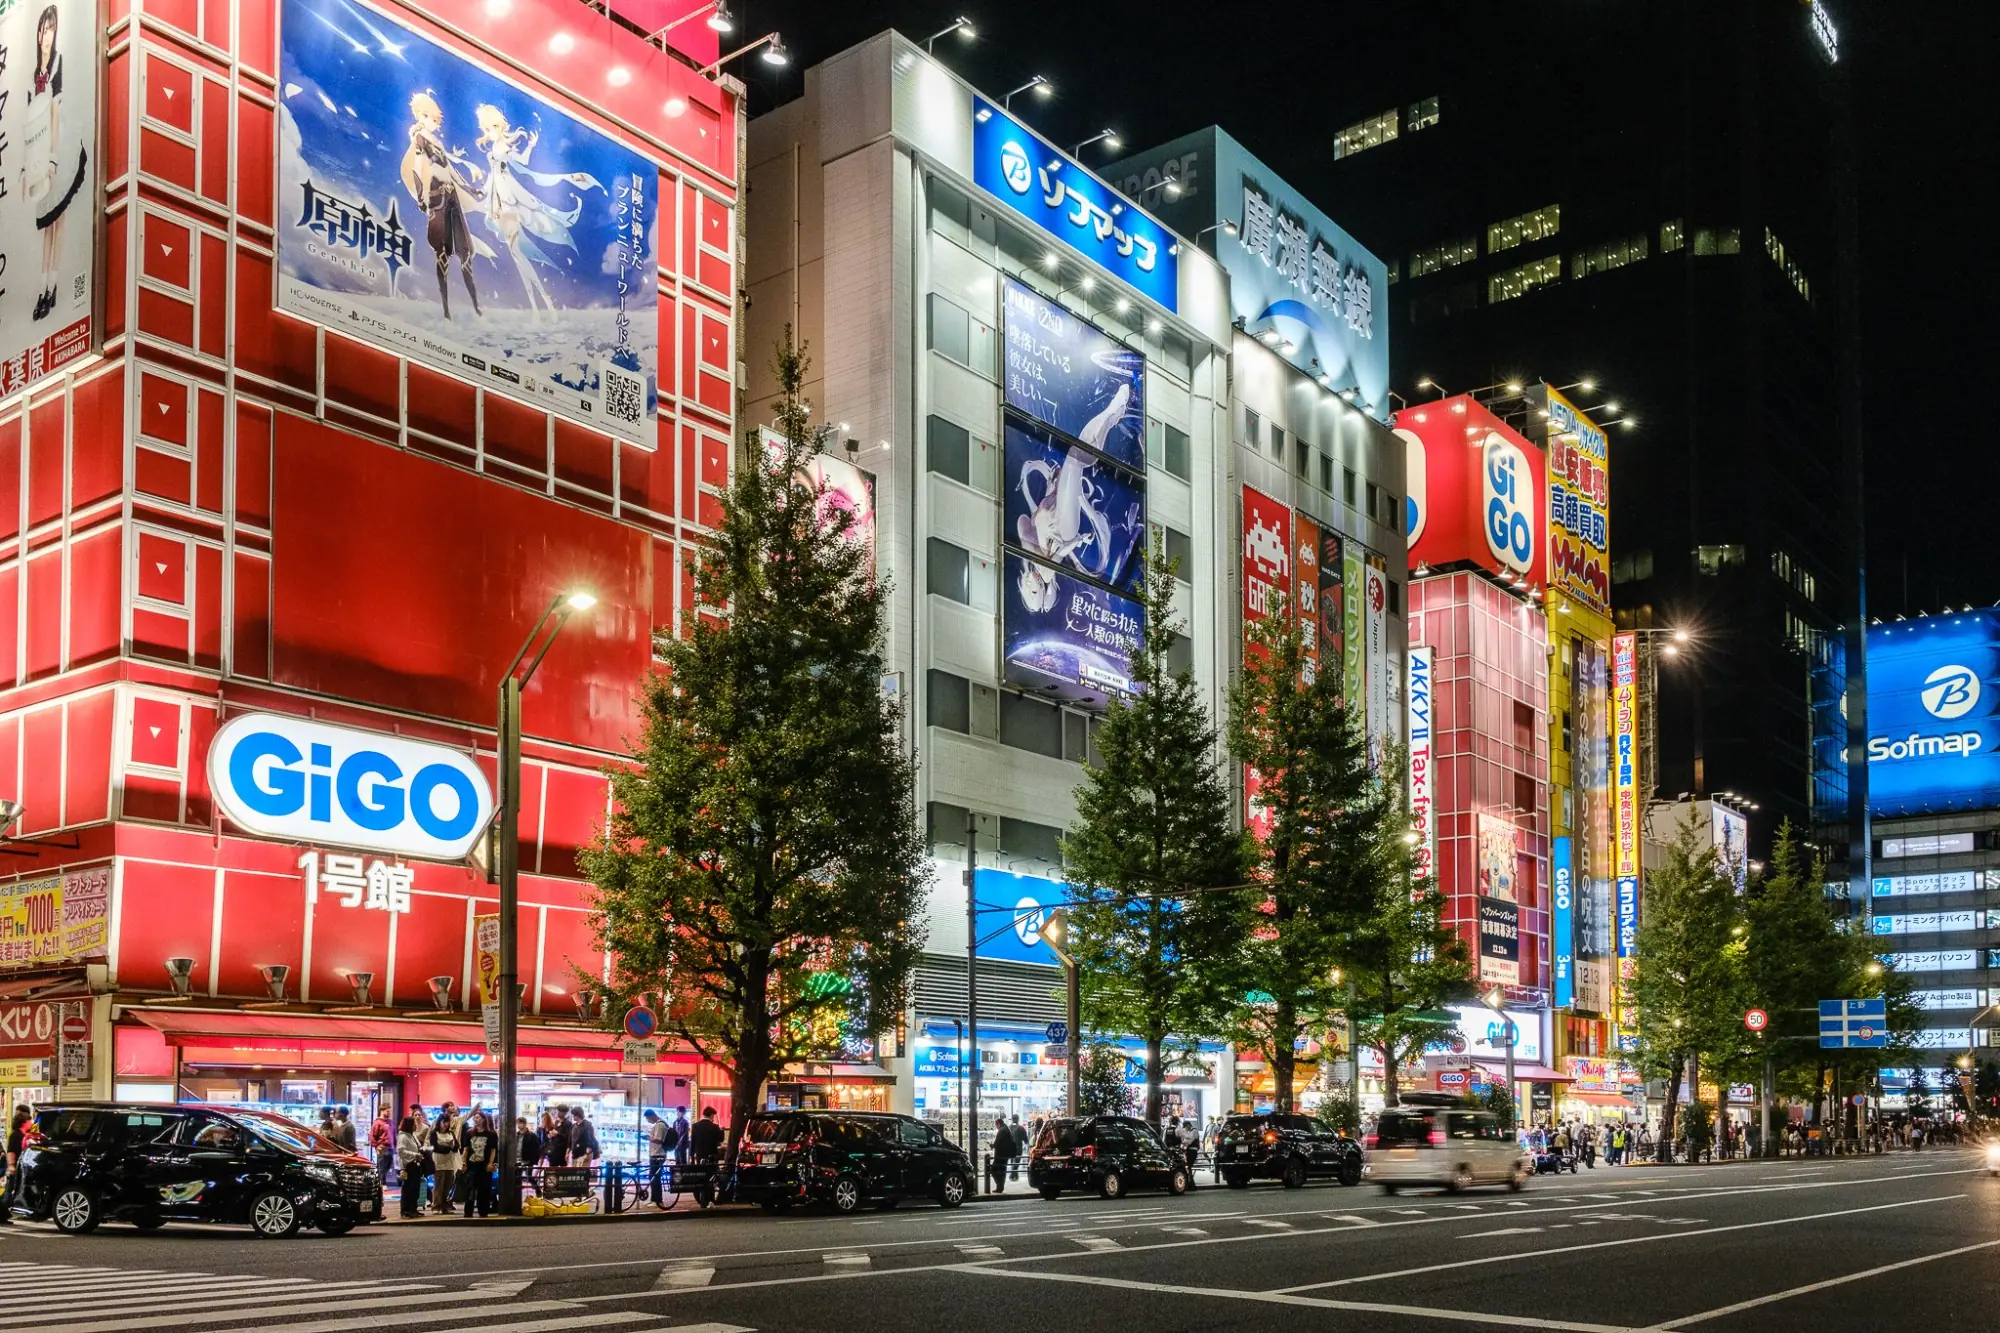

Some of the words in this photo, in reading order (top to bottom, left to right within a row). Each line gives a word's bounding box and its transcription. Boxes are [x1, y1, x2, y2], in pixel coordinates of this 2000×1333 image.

[1114, 152, 1197, 210] ROSE
[297, 179, 412, 296] 原神
[632, 173, 642, 270] 冒険に満ちた
[1038, 167, 1157, 272] ソフマップ
[307, 243, 375, 279] Genshin
[616, 184, 629, 359] ブランニューワールドへ
[54, 328, 79, 347] Welcome
[80, 323, 86, 333] to
[54, 339, 86, 365] AKIHABARA
[361, 315, 387, 331] PS5
[393, 327, 417, 342] PS4
[423, 339, 457, 360] Windows
[1552, 486, 1605, 548] 高額買取
[1411, 655, 1429, 724] AKKY
[1619, 734, 1632, 785] AKIBA
[1868, 733, 1982, 763] Sofmap
[229, 732, 479, 841] GiGO
[65, 874, 107, 895] ギフトカード
[299, 852, 414, 914] 1号館
[1556, 867, 1569, 909] GiGO
[1876, 882, 1890, 893] 7F
[24, 893, 54, 937] 7000
[1896, 914, 1971, 926] ゲーミングデバイス
[0, 1007, 31, 1040] くじ
[1047, 1027, 1066, 1037] 437
[1750, 1015, 1762, 1025] 50
[1441, 1074, 1464, 1082] GiGO
